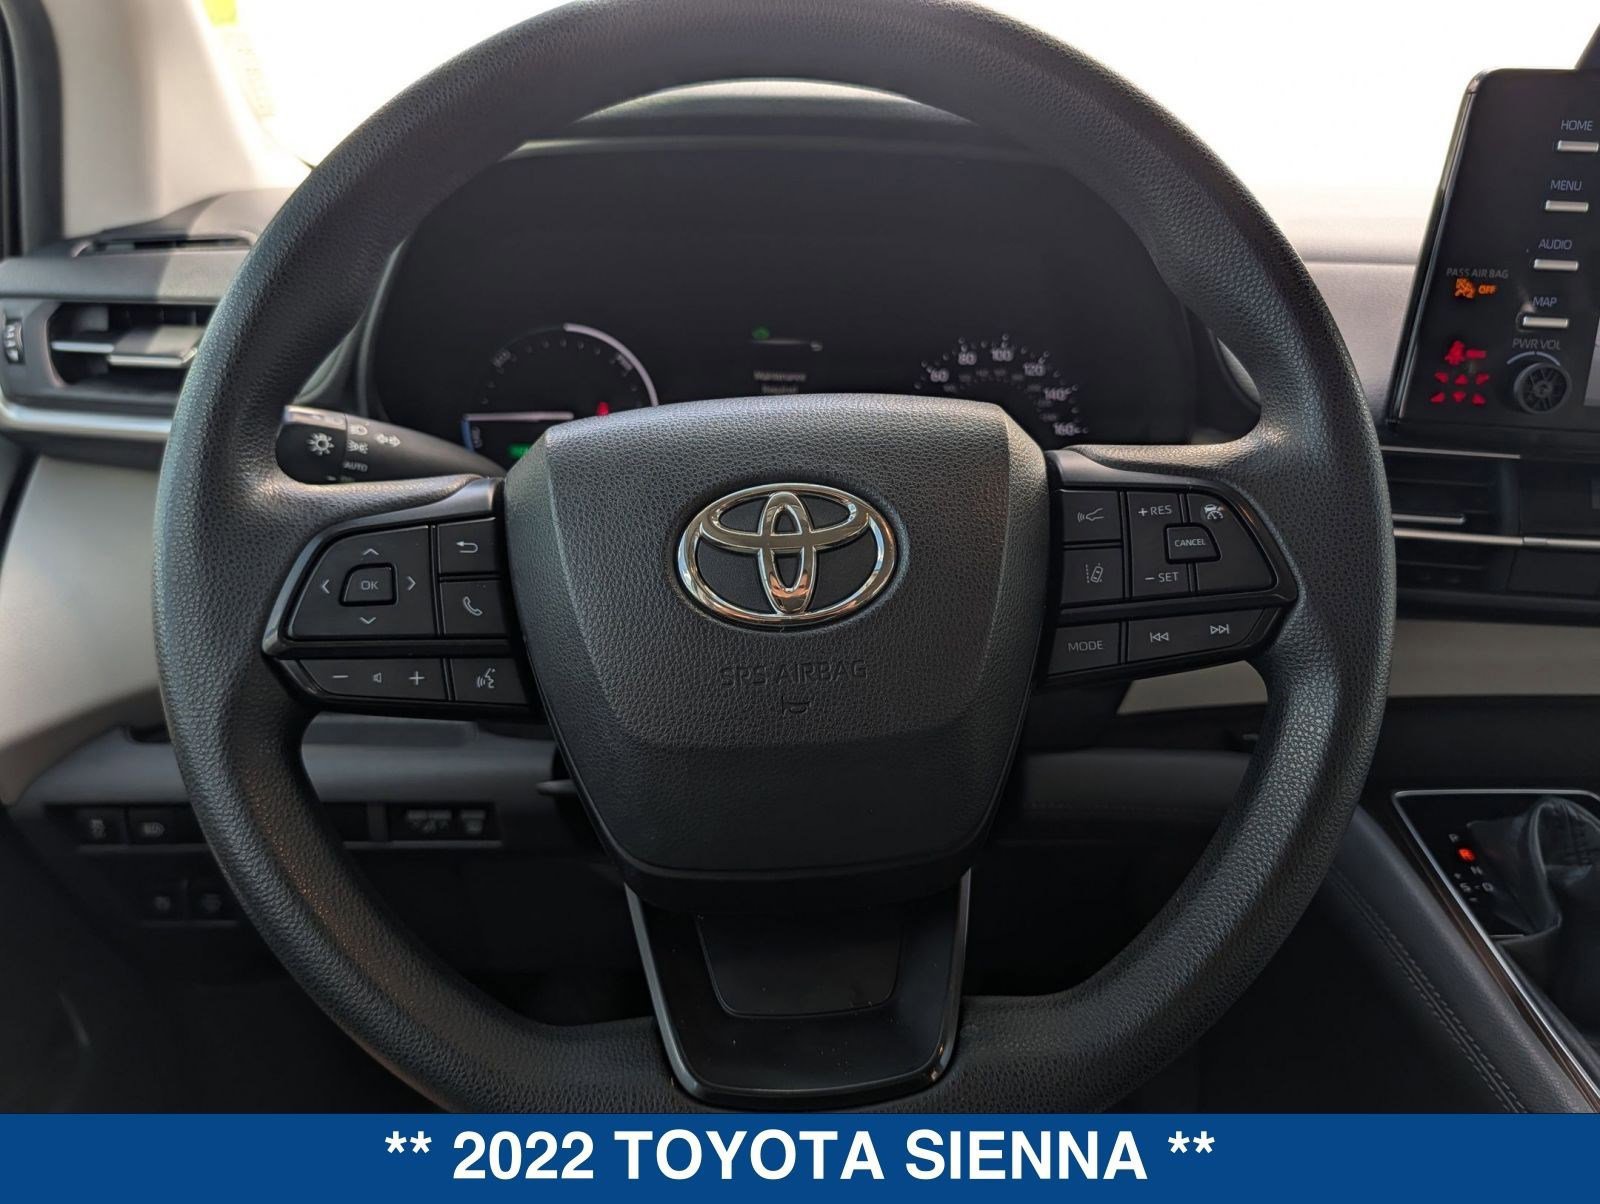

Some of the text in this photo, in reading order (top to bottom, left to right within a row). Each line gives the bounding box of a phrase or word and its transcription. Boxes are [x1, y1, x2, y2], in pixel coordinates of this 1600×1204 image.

[1560, 119, 1593, 132] HOME
[1550, 179, 1582, 191] MENU
[1537, 238, 1573, 250] AUDIO
[1446, 267, 1470, 277] PASS
[1532, 296, 1558, 308] MAP
[1511, 337, 1561, 351] PWR VOL
[958, 351, 977, 365] 80
[992, 347, 1014, 362] 100
[1023, 362, 1046, 376] 120
[342, 461, 369, 473] AUTO
[1174, 538, 1207, 548] CANCEL
[360, 580, 379, 591] OK
[1067, 640, 1104, 652] MODE
[720, 659, 869, 687] SRS AIRBAG
